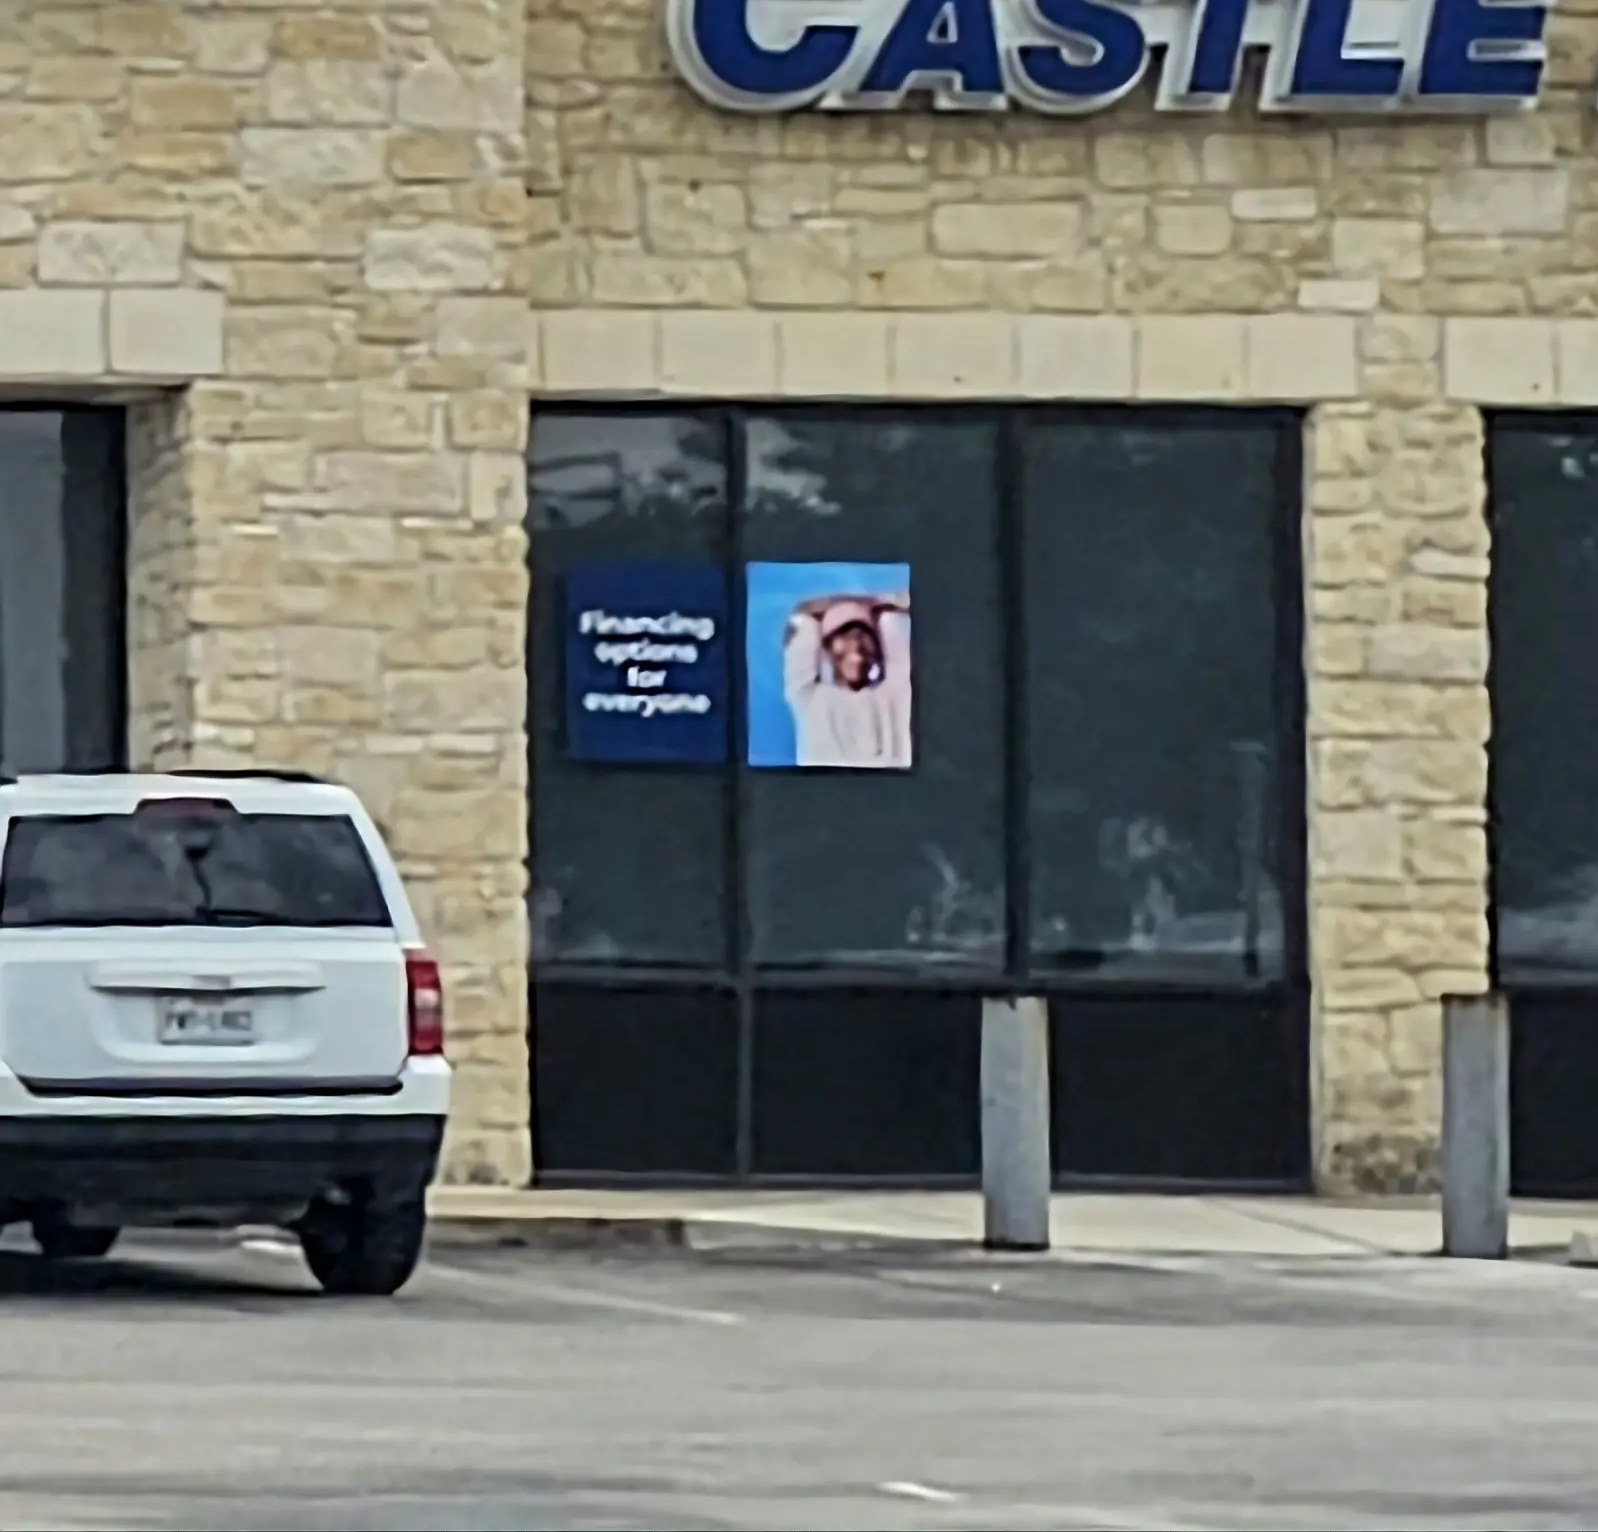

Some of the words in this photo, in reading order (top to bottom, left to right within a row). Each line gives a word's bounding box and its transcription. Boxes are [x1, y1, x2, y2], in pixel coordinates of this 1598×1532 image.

[580, 609, 715, 640] Financing
[594, 638, 698, 666] options
[627, 666, 667, 687] for
[582, 692, 711, 717] everyone
